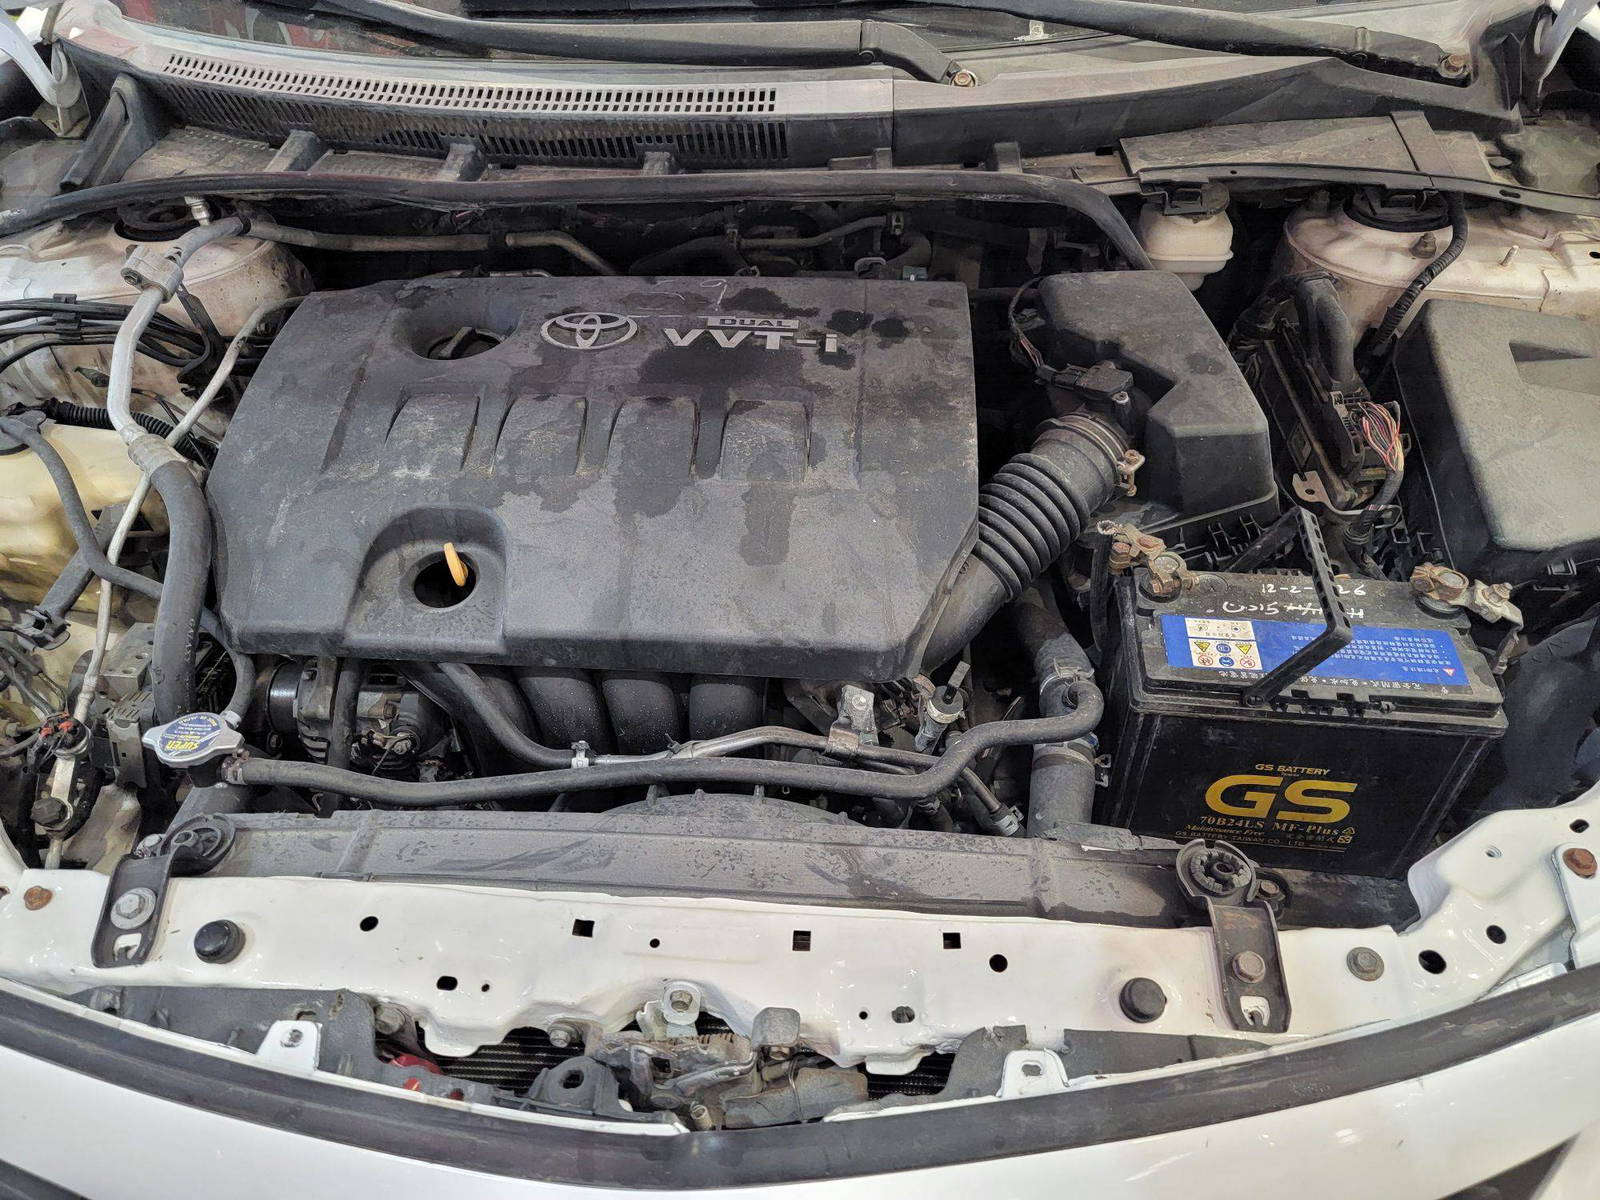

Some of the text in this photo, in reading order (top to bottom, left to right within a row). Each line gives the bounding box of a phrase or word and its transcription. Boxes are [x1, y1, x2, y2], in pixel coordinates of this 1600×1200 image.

[719, 318, 791, 327] DUAL
[664, 328, 838, 352] VVT-i
[1255, 763, 1274, 771] GS
[1277, 765, 1331, 776] BATTERY
[1205, 774, 1358, 824] GS
[1272, 821, 1340, 835] MF-Plus
